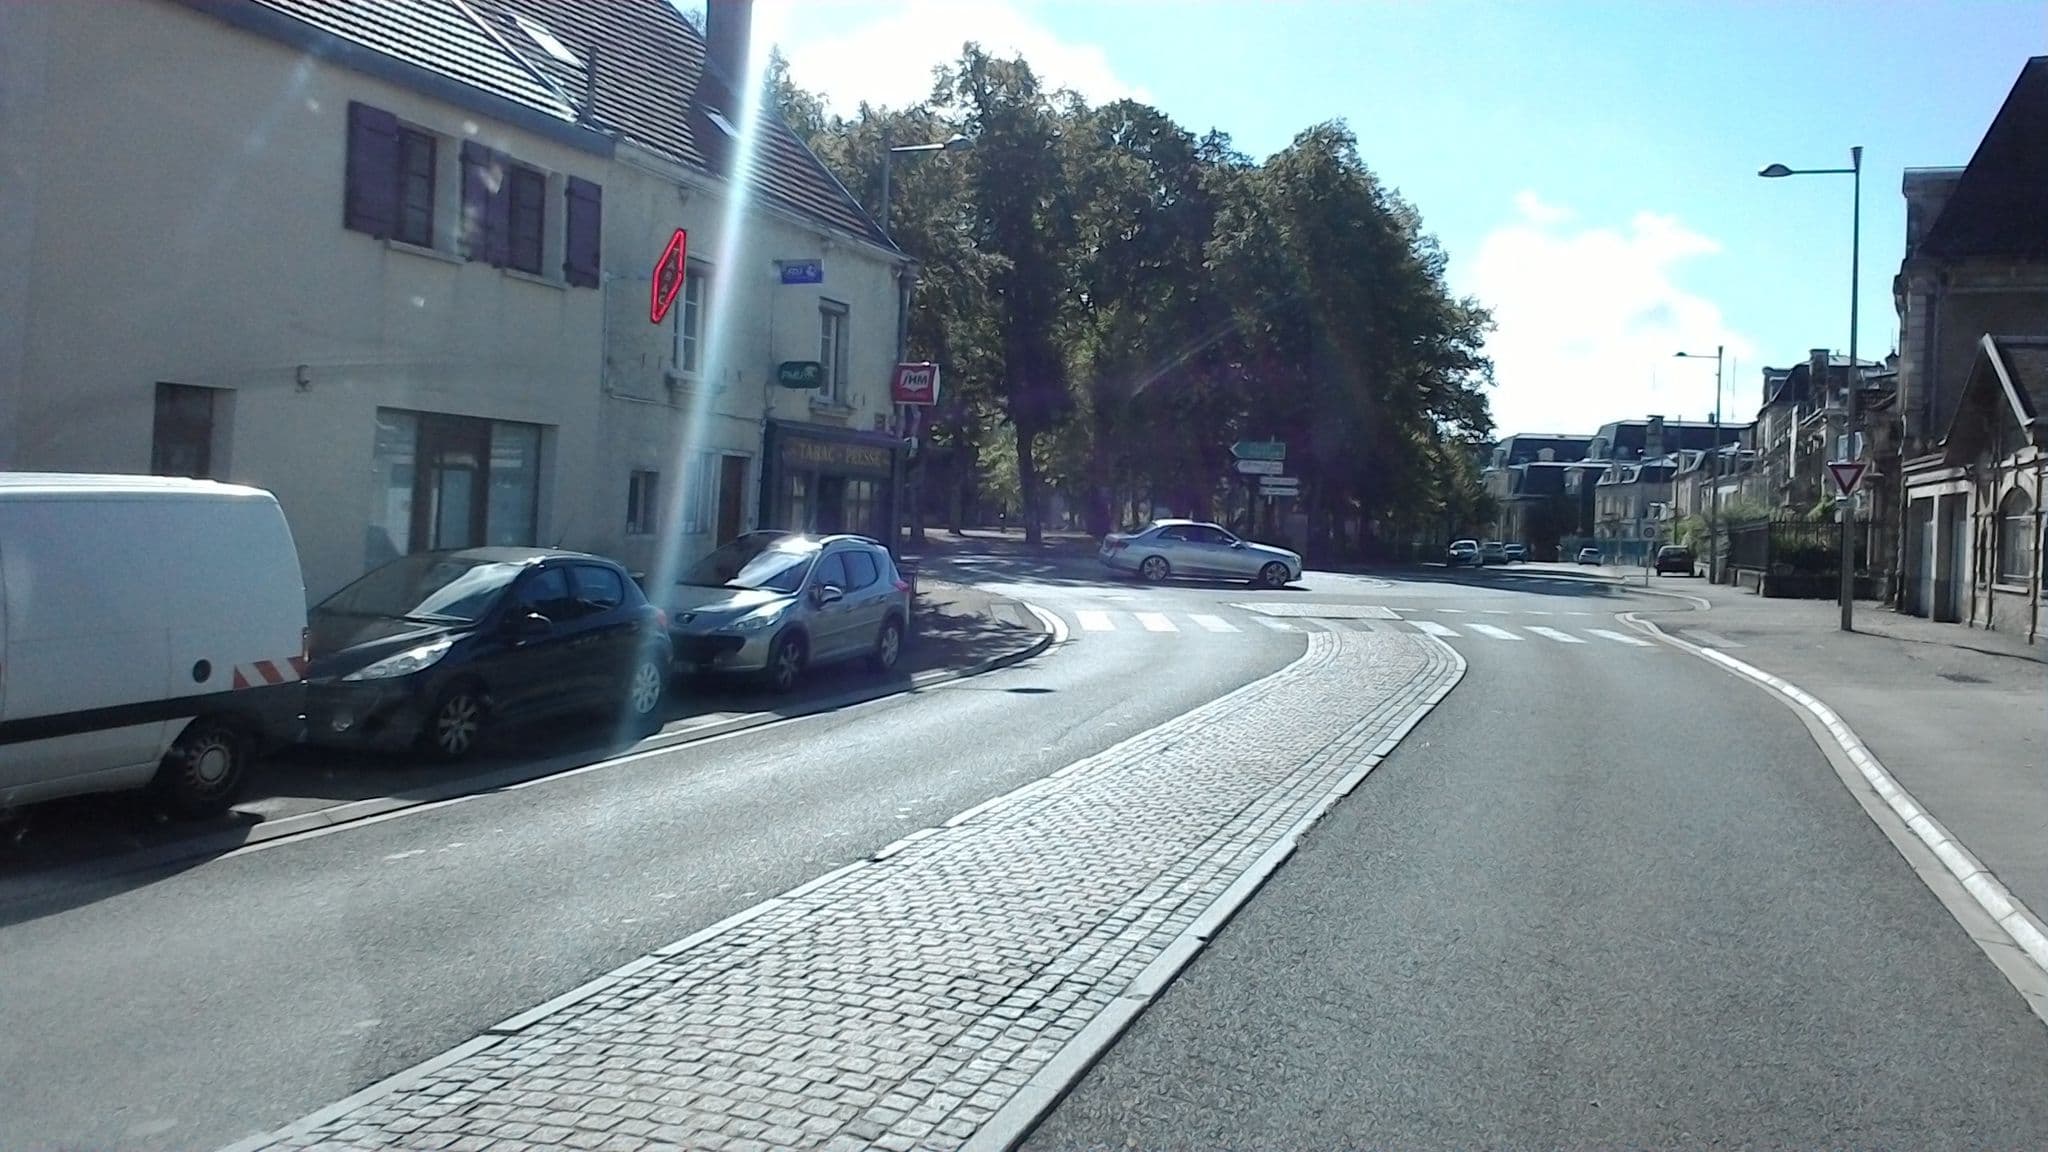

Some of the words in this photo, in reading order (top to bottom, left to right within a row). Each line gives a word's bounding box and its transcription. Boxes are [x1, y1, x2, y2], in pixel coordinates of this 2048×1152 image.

[658, 247, 680, 305] TABAC
[799, 443, 834, 463] TABAC
[845, 447, 881, 466] PRESSE
